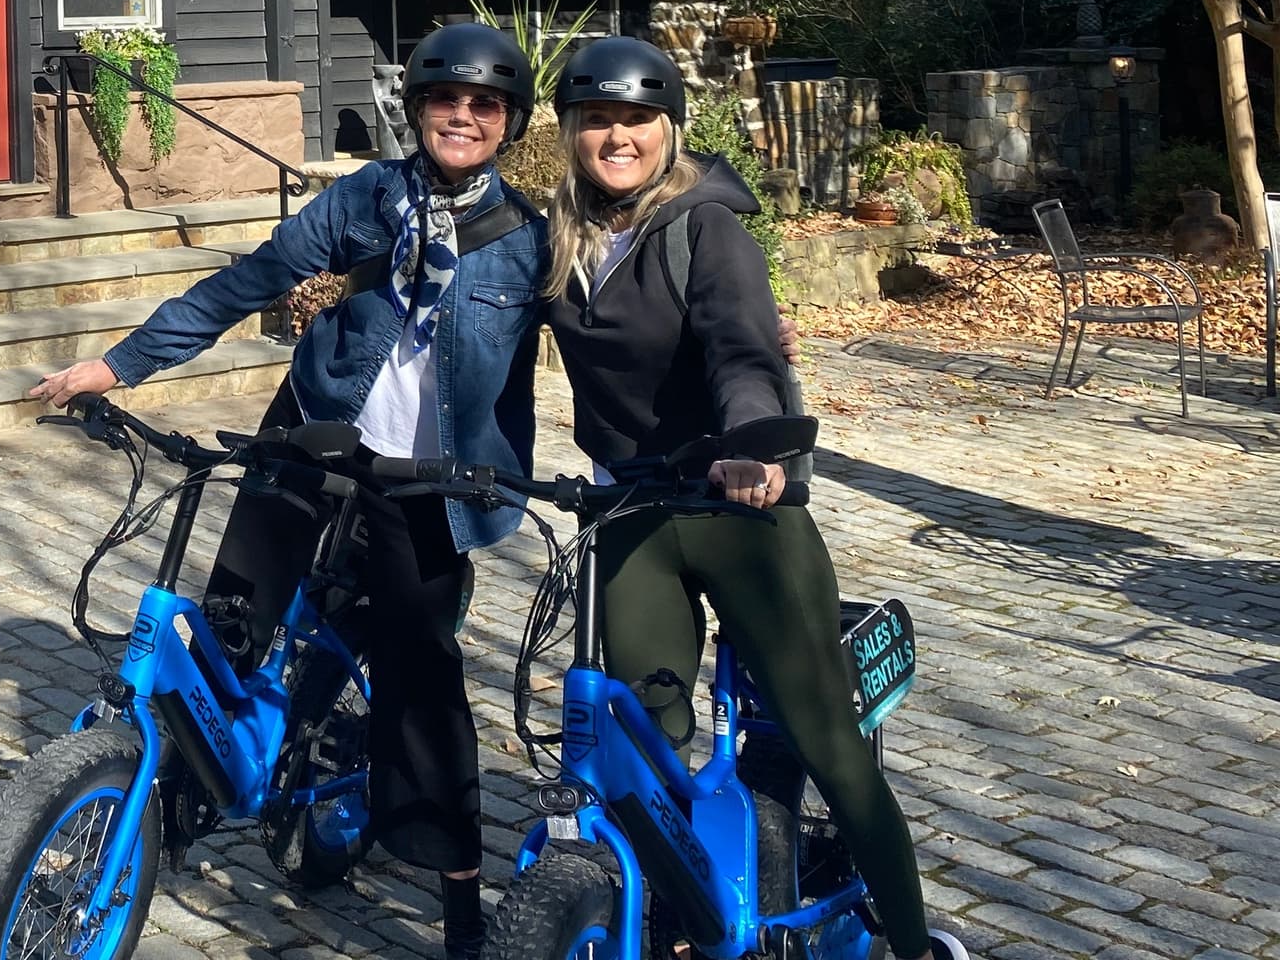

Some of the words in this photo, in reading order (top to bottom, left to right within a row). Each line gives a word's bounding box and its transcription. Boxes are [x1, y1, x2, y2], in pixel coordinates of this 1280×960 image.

[278, 626, 286, 636] 2
[853, 621, 892, 670] SALES
[890, 613, 904, 637] &
[860, 639, 914, 704] RENTALS
[188, 685, 231, 759] PEDEGO
[716, 705, 726, 716] 2
[650, 789, 710, 881] PEDEGO
